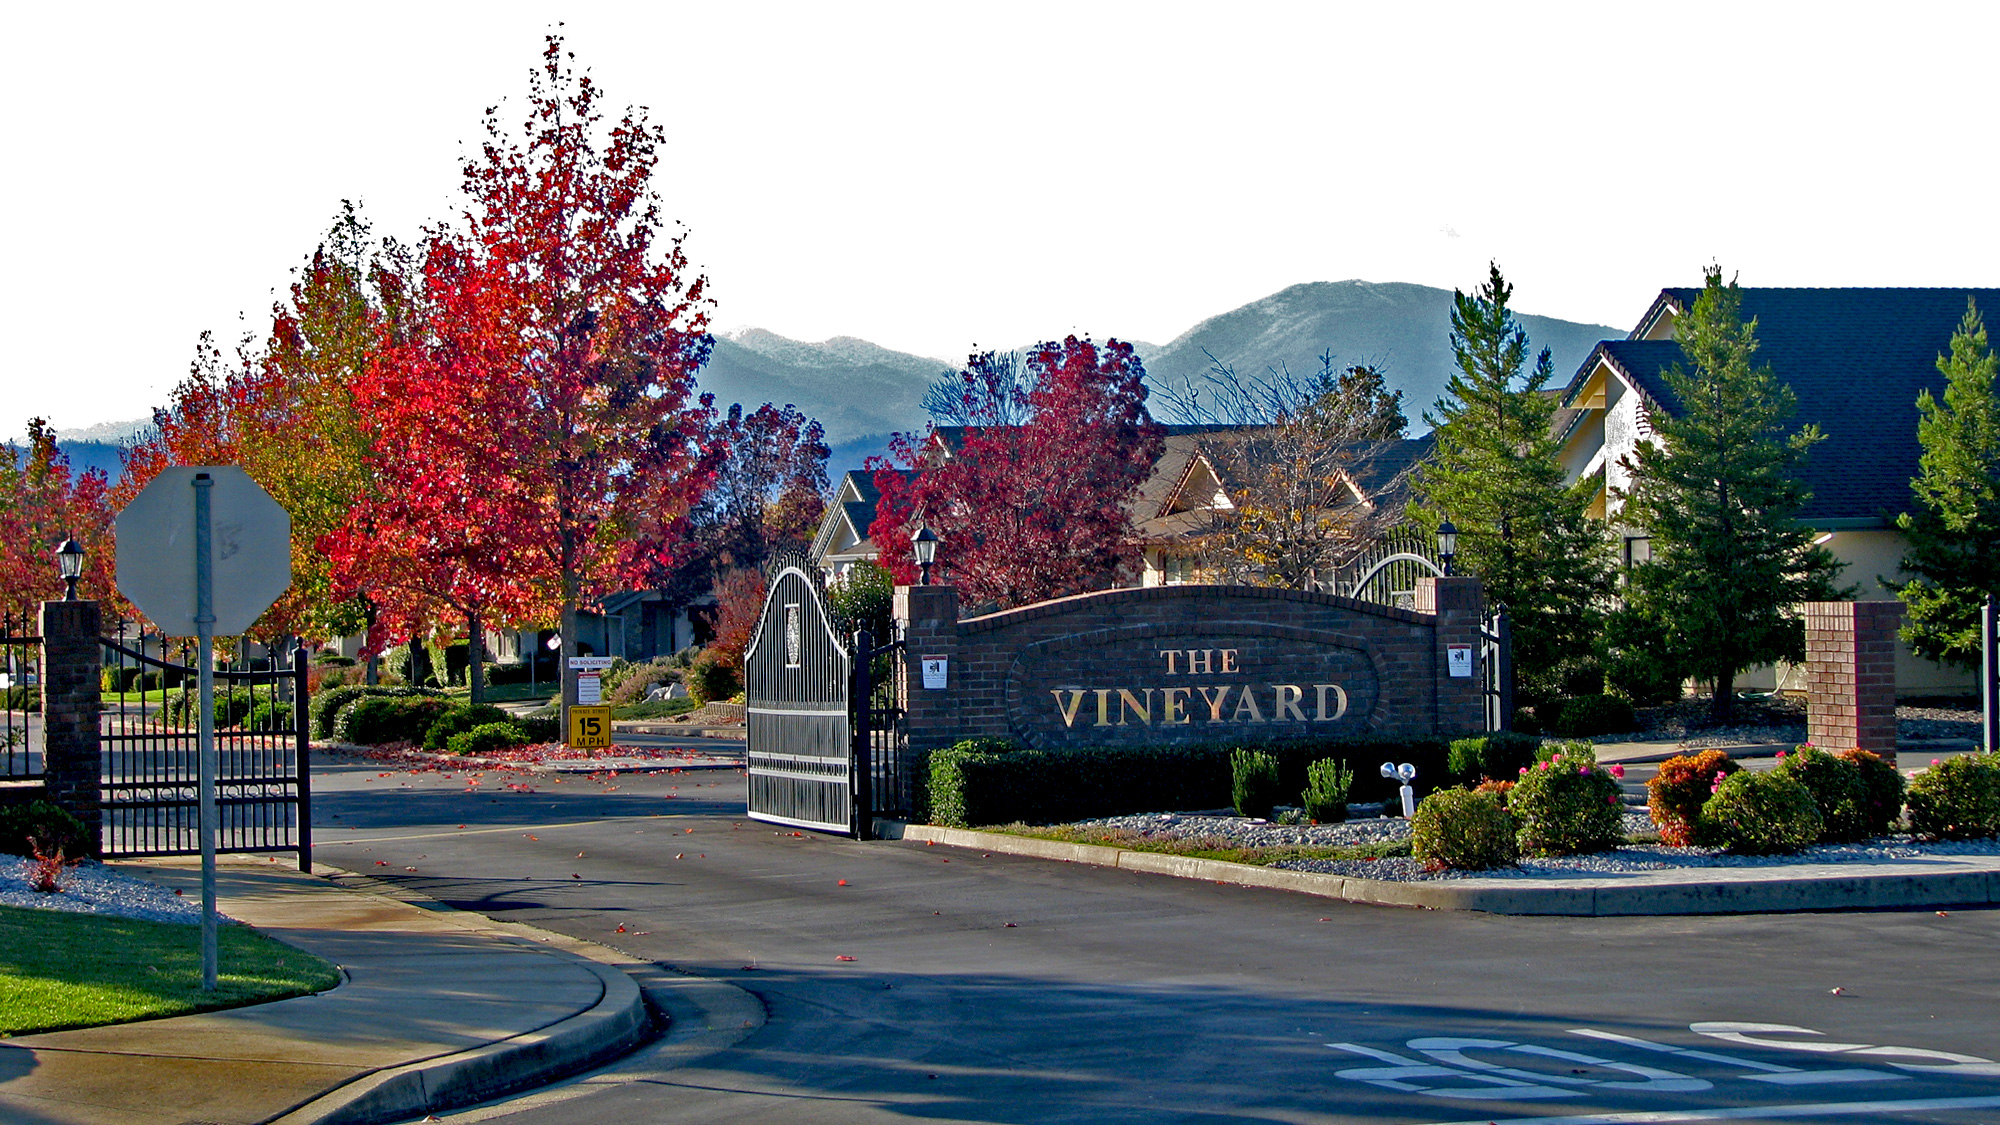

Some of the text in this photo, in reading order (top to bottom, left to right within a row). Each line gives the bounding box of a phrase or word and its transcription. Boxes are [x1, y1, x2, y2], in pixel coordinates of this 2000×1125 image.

[1160, 648, 1240, 675] THE
[1050, 684, 1348, 728] VINEYARD
[579, 717, 602, 736] 15
[576, 737, 604, 746] MPH
[1324, 1021, 2000, 1099] STOP
